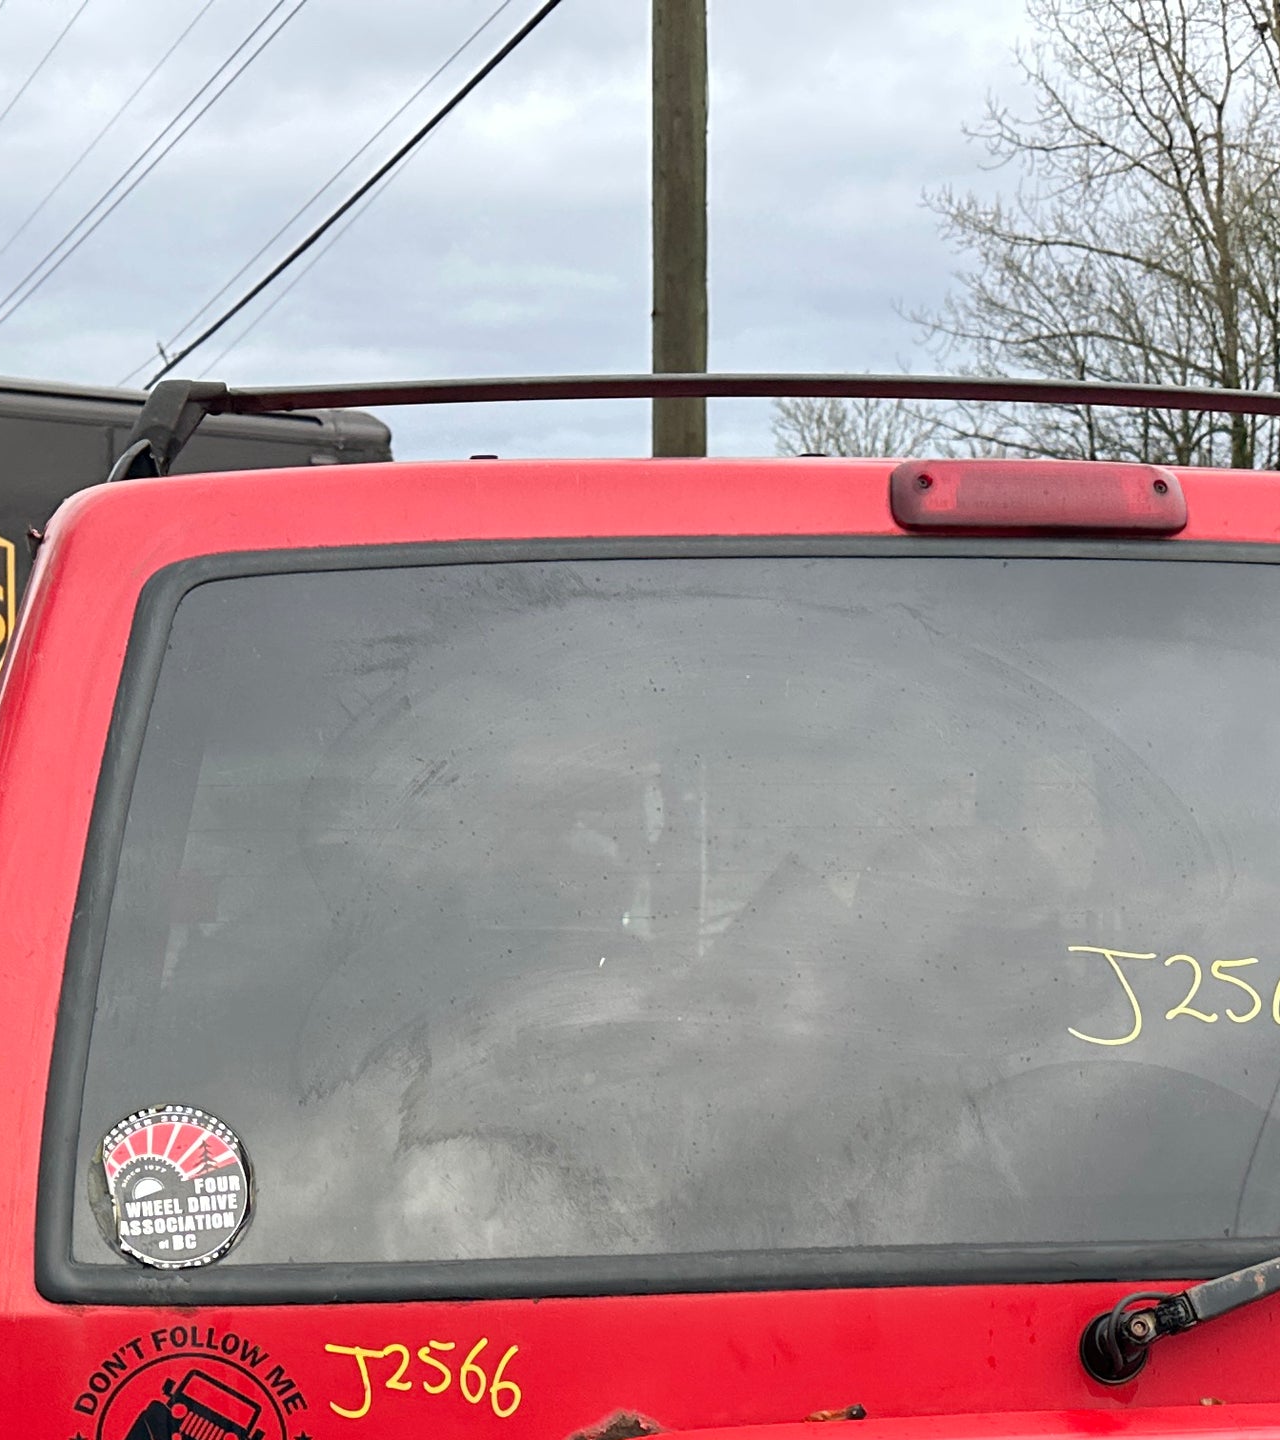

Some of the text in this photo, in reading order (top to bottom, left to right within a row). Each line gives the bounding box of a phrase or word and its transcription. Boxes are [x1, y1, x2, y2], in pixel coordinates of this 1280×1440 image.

[194, 1175, 241, 1195] FOUR
[125, 1193, 238, 1218] WHEEL DRIVE
[120, 1212, 235, 1236] ASSOCIATION
[172, 1234, 197, 1251] BC
[74, 1326, 308, 1417] DON'T FOLLOW ME
[325, 1337, 522, 1418] J2566
